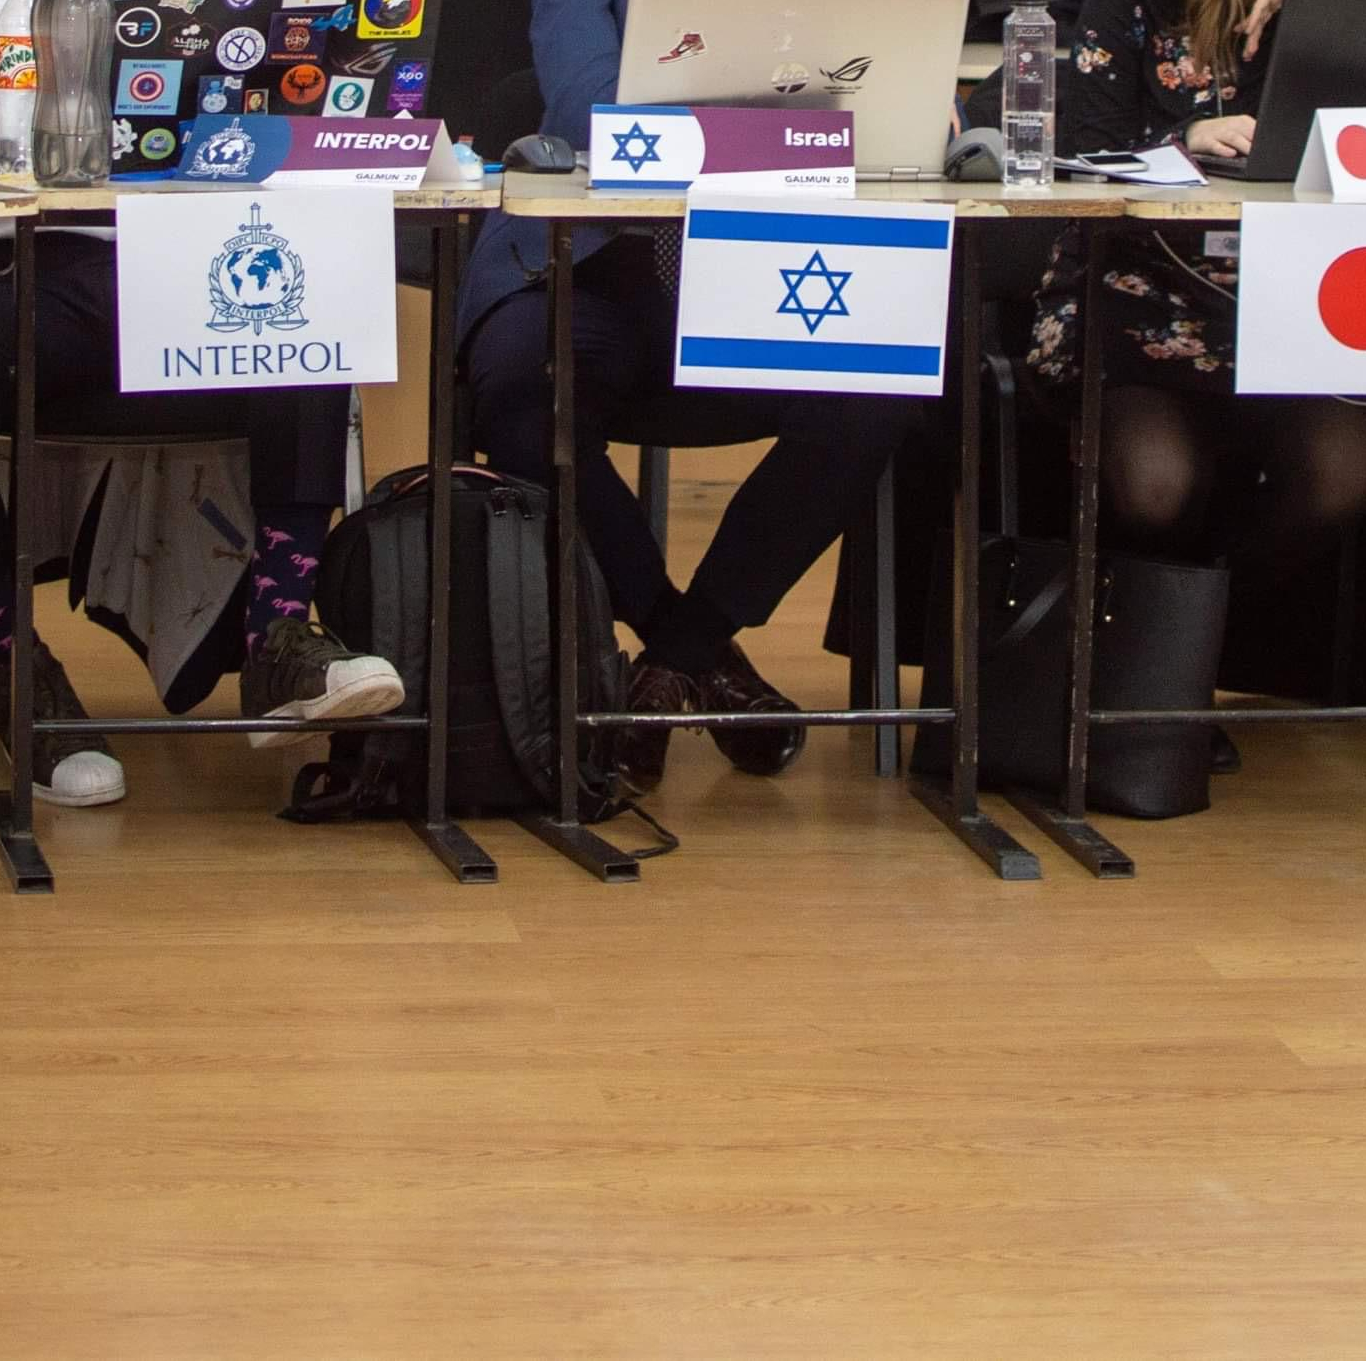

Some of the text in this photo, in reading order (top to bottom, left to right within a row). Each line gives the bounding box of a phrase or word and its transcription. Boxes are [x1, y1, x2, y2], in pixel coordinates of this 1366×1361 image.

[314, 132, 431, 151] INTERPOL
[785, 127, 849, 147] Israel
[355, 172, 399, 181] GALMUN
[784, 175, 830, 184] GALMUN
[228, 237, 250, 250] OIPC
[231, 305, 283, 320] INTERPOL
[164, 341, 352, 377] INTERPOL
